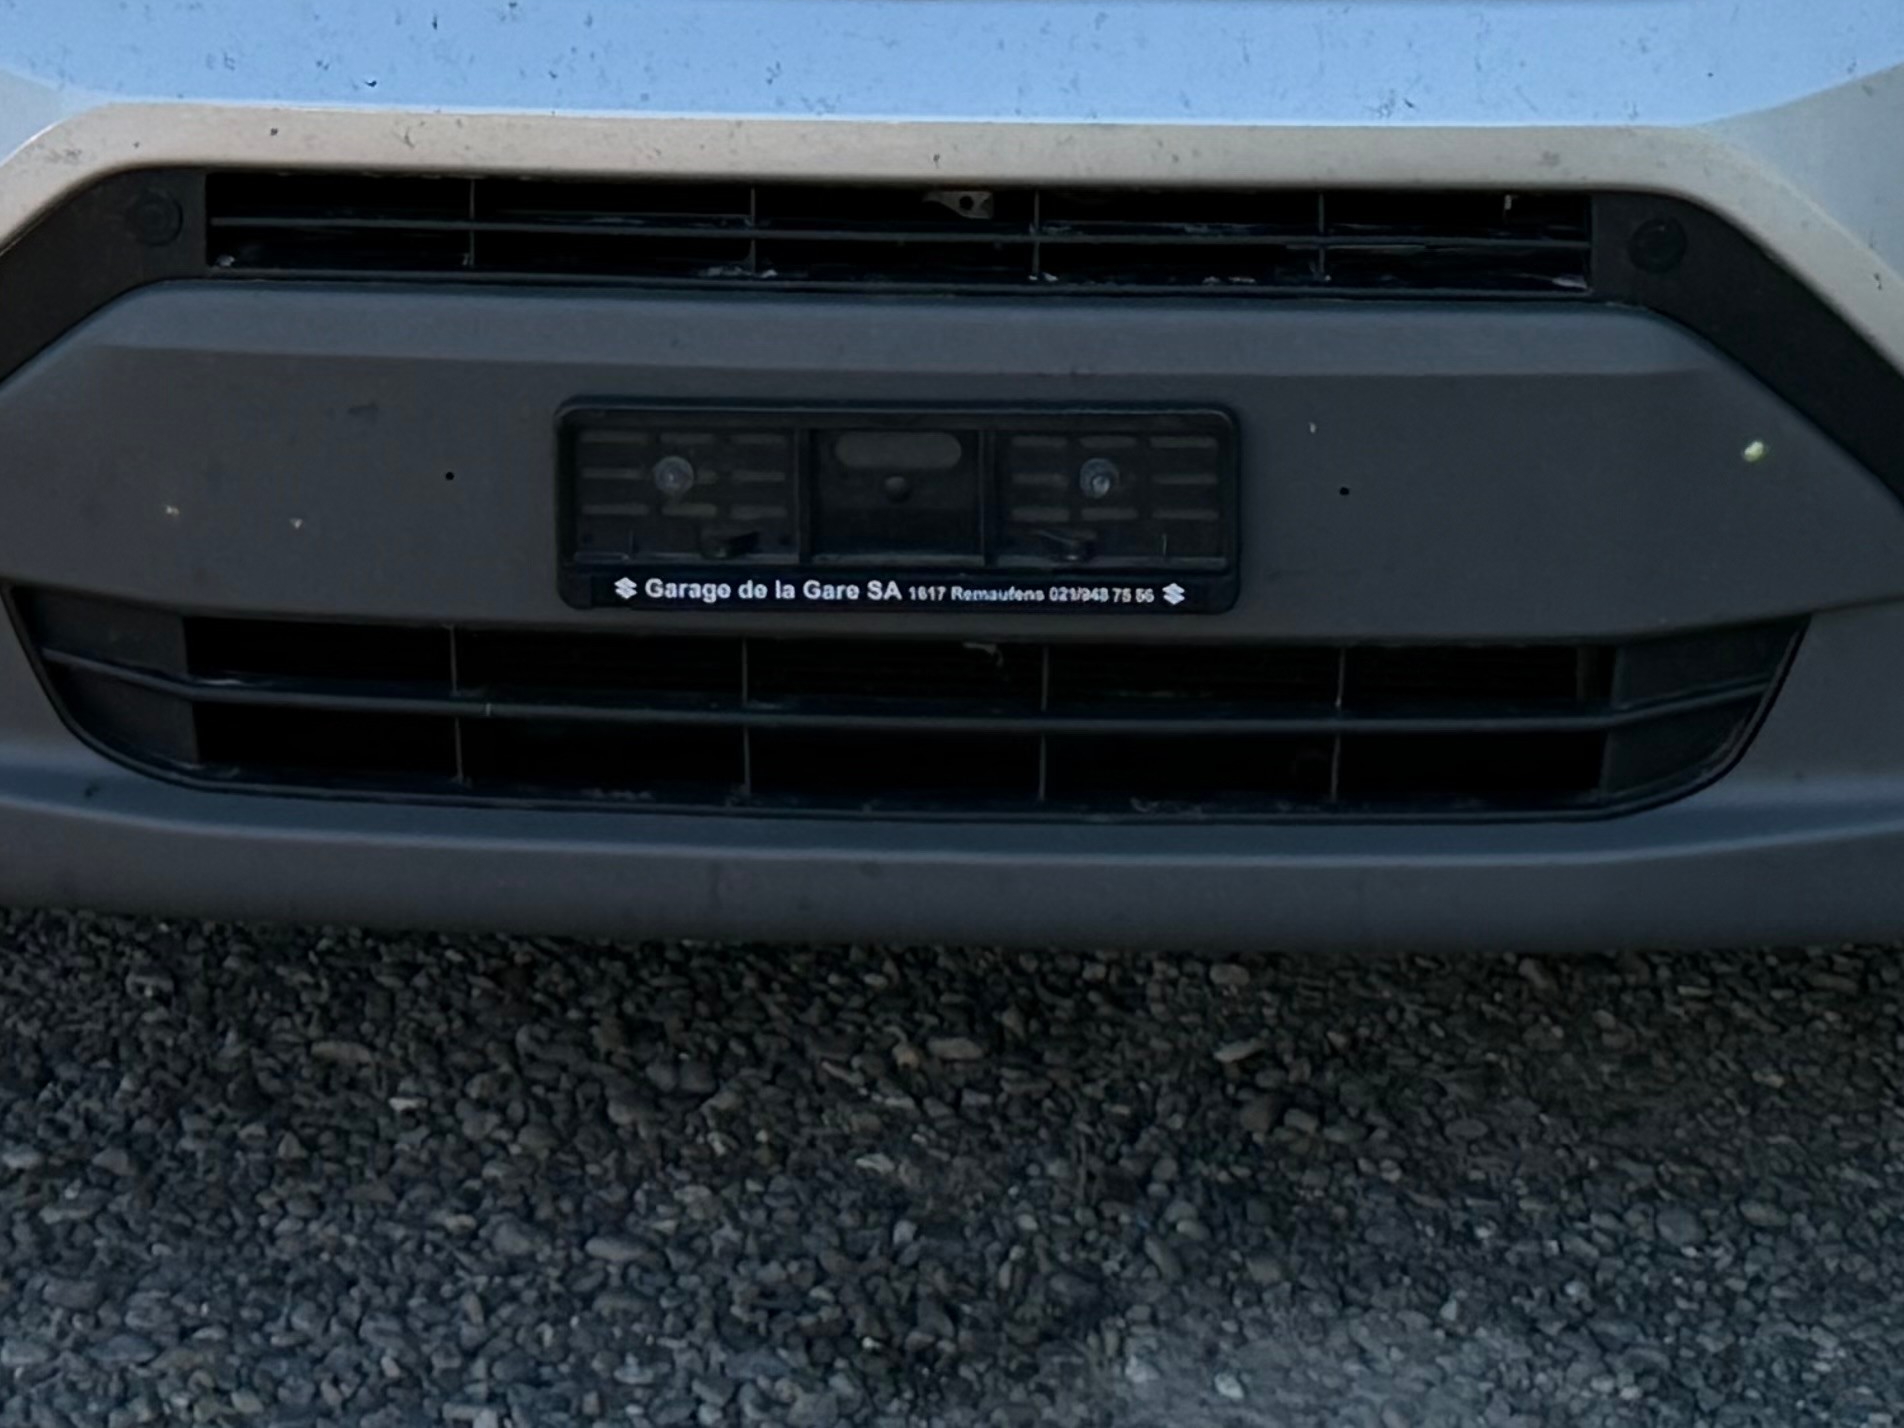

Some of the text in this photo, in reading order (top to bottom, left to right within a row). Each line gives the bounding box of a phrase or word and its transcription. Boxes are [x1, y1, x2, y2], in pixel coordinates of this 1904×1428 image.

[645, 578, 731, 603] Garage
[738, 580, 767, 599] de
[776, 580, 795, 599] la
[803, 580, 859, 600] Gare
[867, 580, 902, 600] SA
[951, 586, 1044, 601] Remaufens
